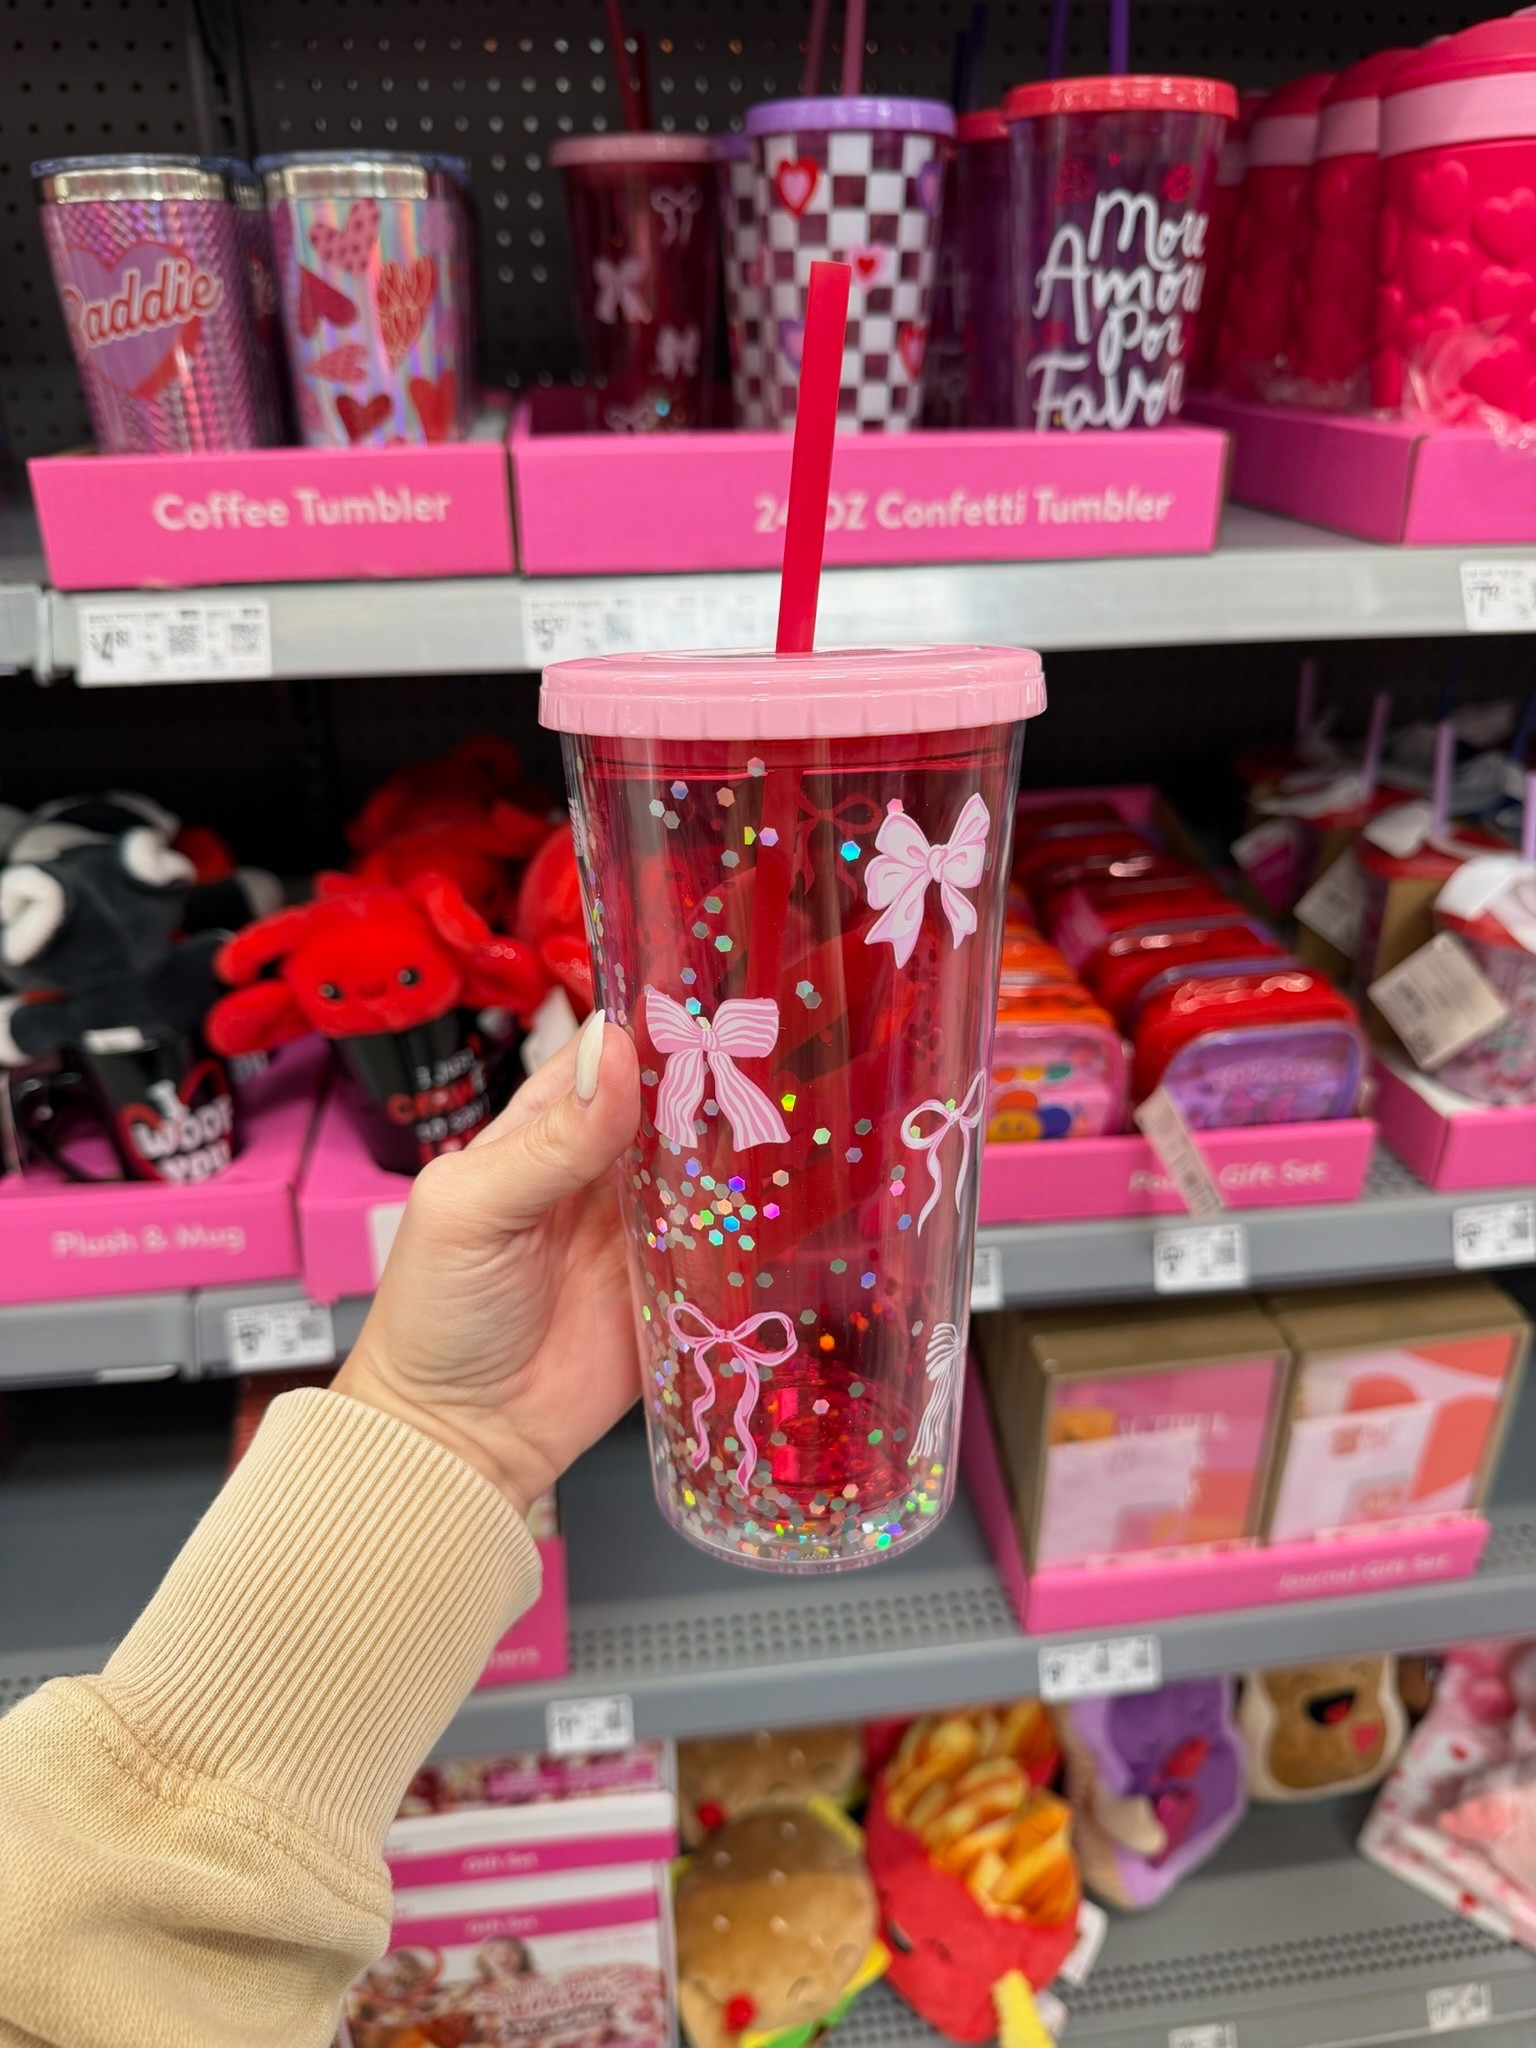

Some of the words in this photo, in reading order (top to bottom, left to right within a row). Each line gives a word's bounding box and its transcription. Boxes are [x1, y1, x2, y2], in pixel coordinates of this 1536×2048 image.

[152, 491, 290, 532] Coffee
[294, 484, 450, 526] Tumbler
[753, 496, 788, 534] 2
[875, 485, 1024, 529] Confetti
[1033, 485, 1173, 525] Tumbler
[51, 1226, 138, 1260] Plush
[173, 1222, 246, 1256] Mug
